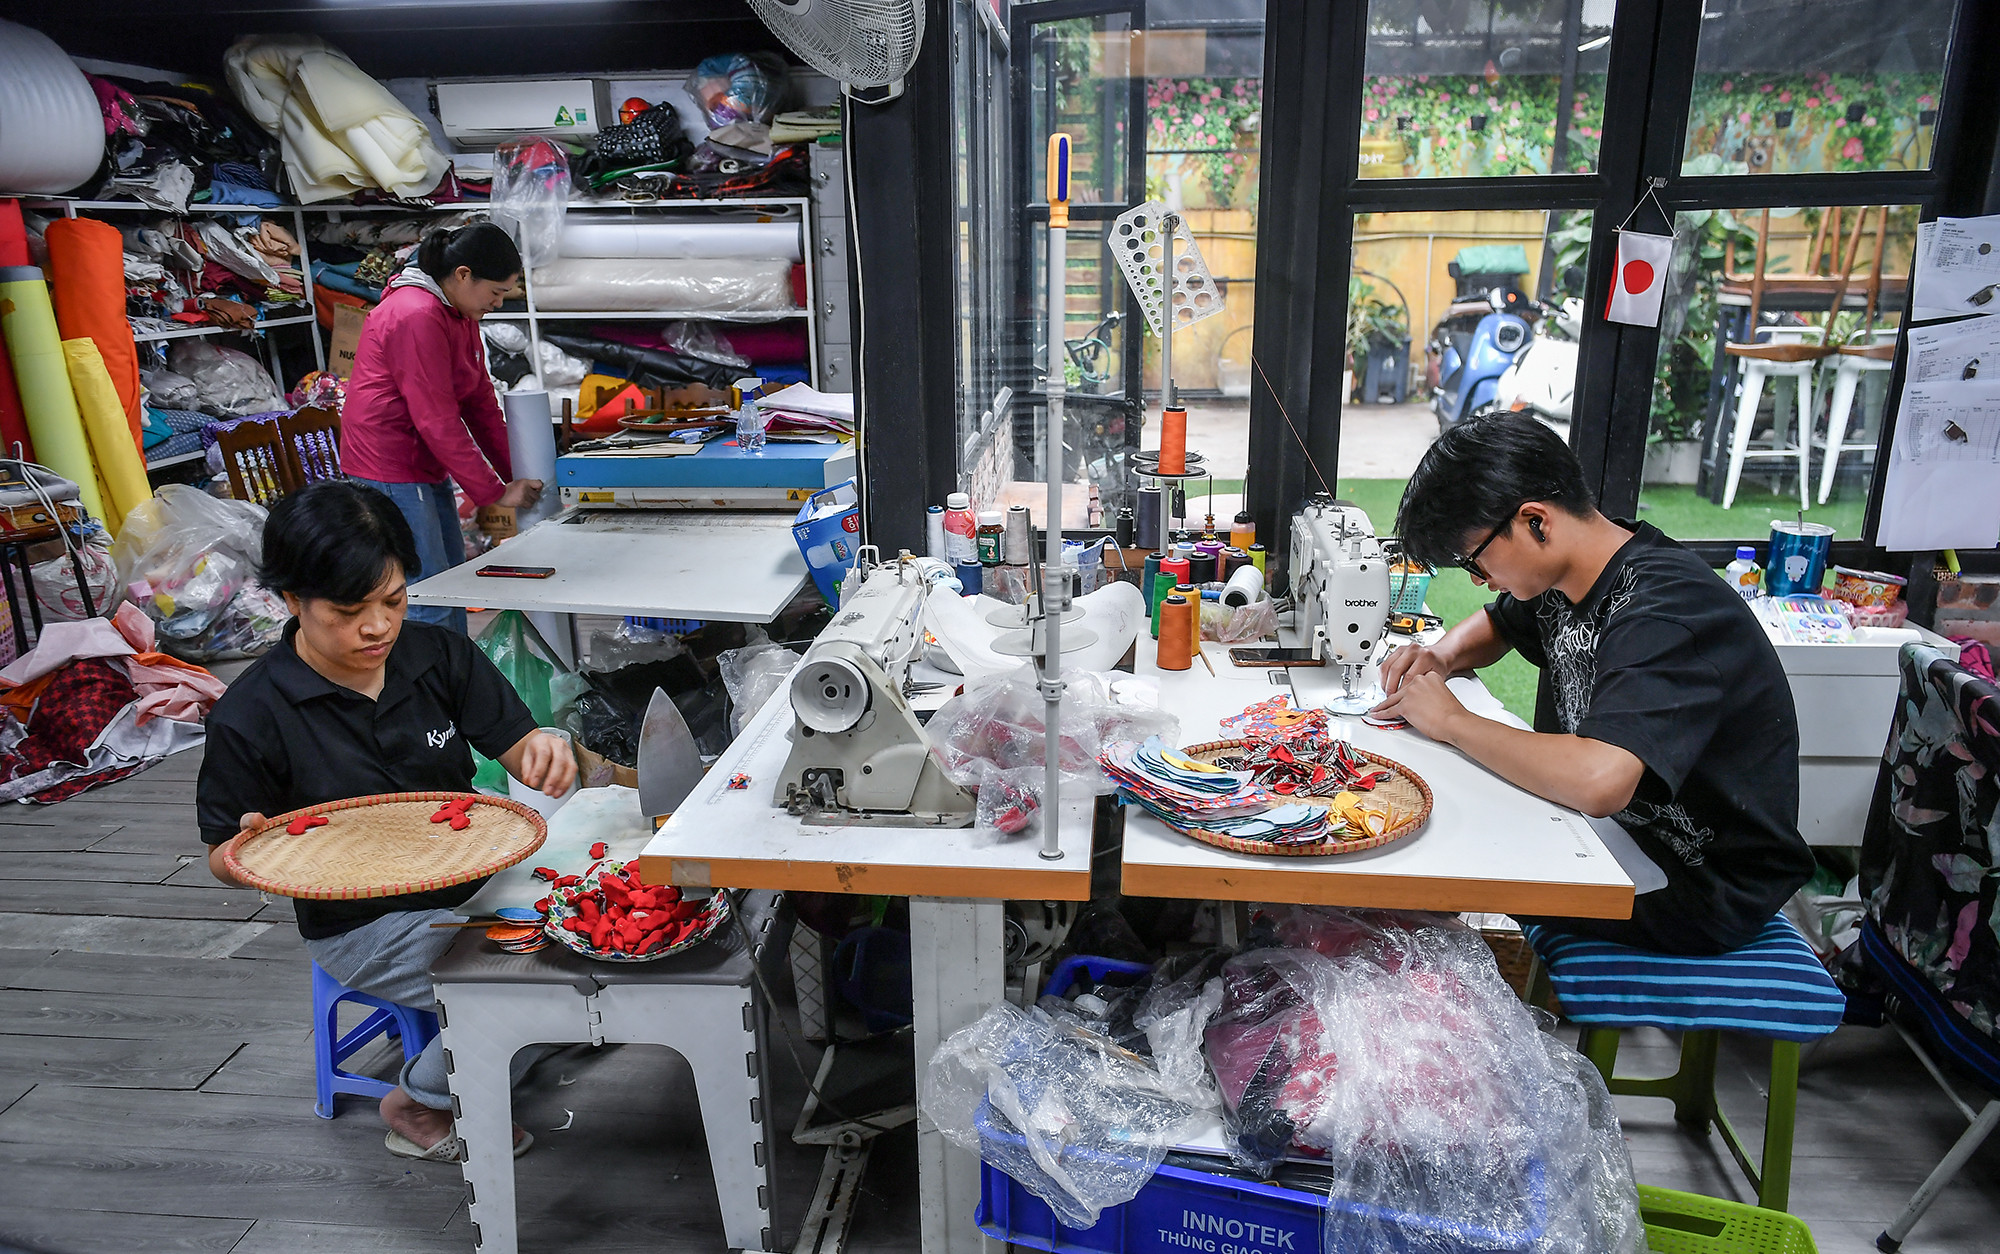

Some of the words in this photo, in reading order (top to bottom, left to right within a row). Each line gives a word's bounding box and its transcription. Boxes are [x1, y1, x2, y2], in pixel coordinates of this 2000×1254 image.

[1344, 599, 1379, 608] brother
[1158, 1229, 1216, 1252] THÙNG
[1182, 1209, 1296, 1251] INNOTEK
